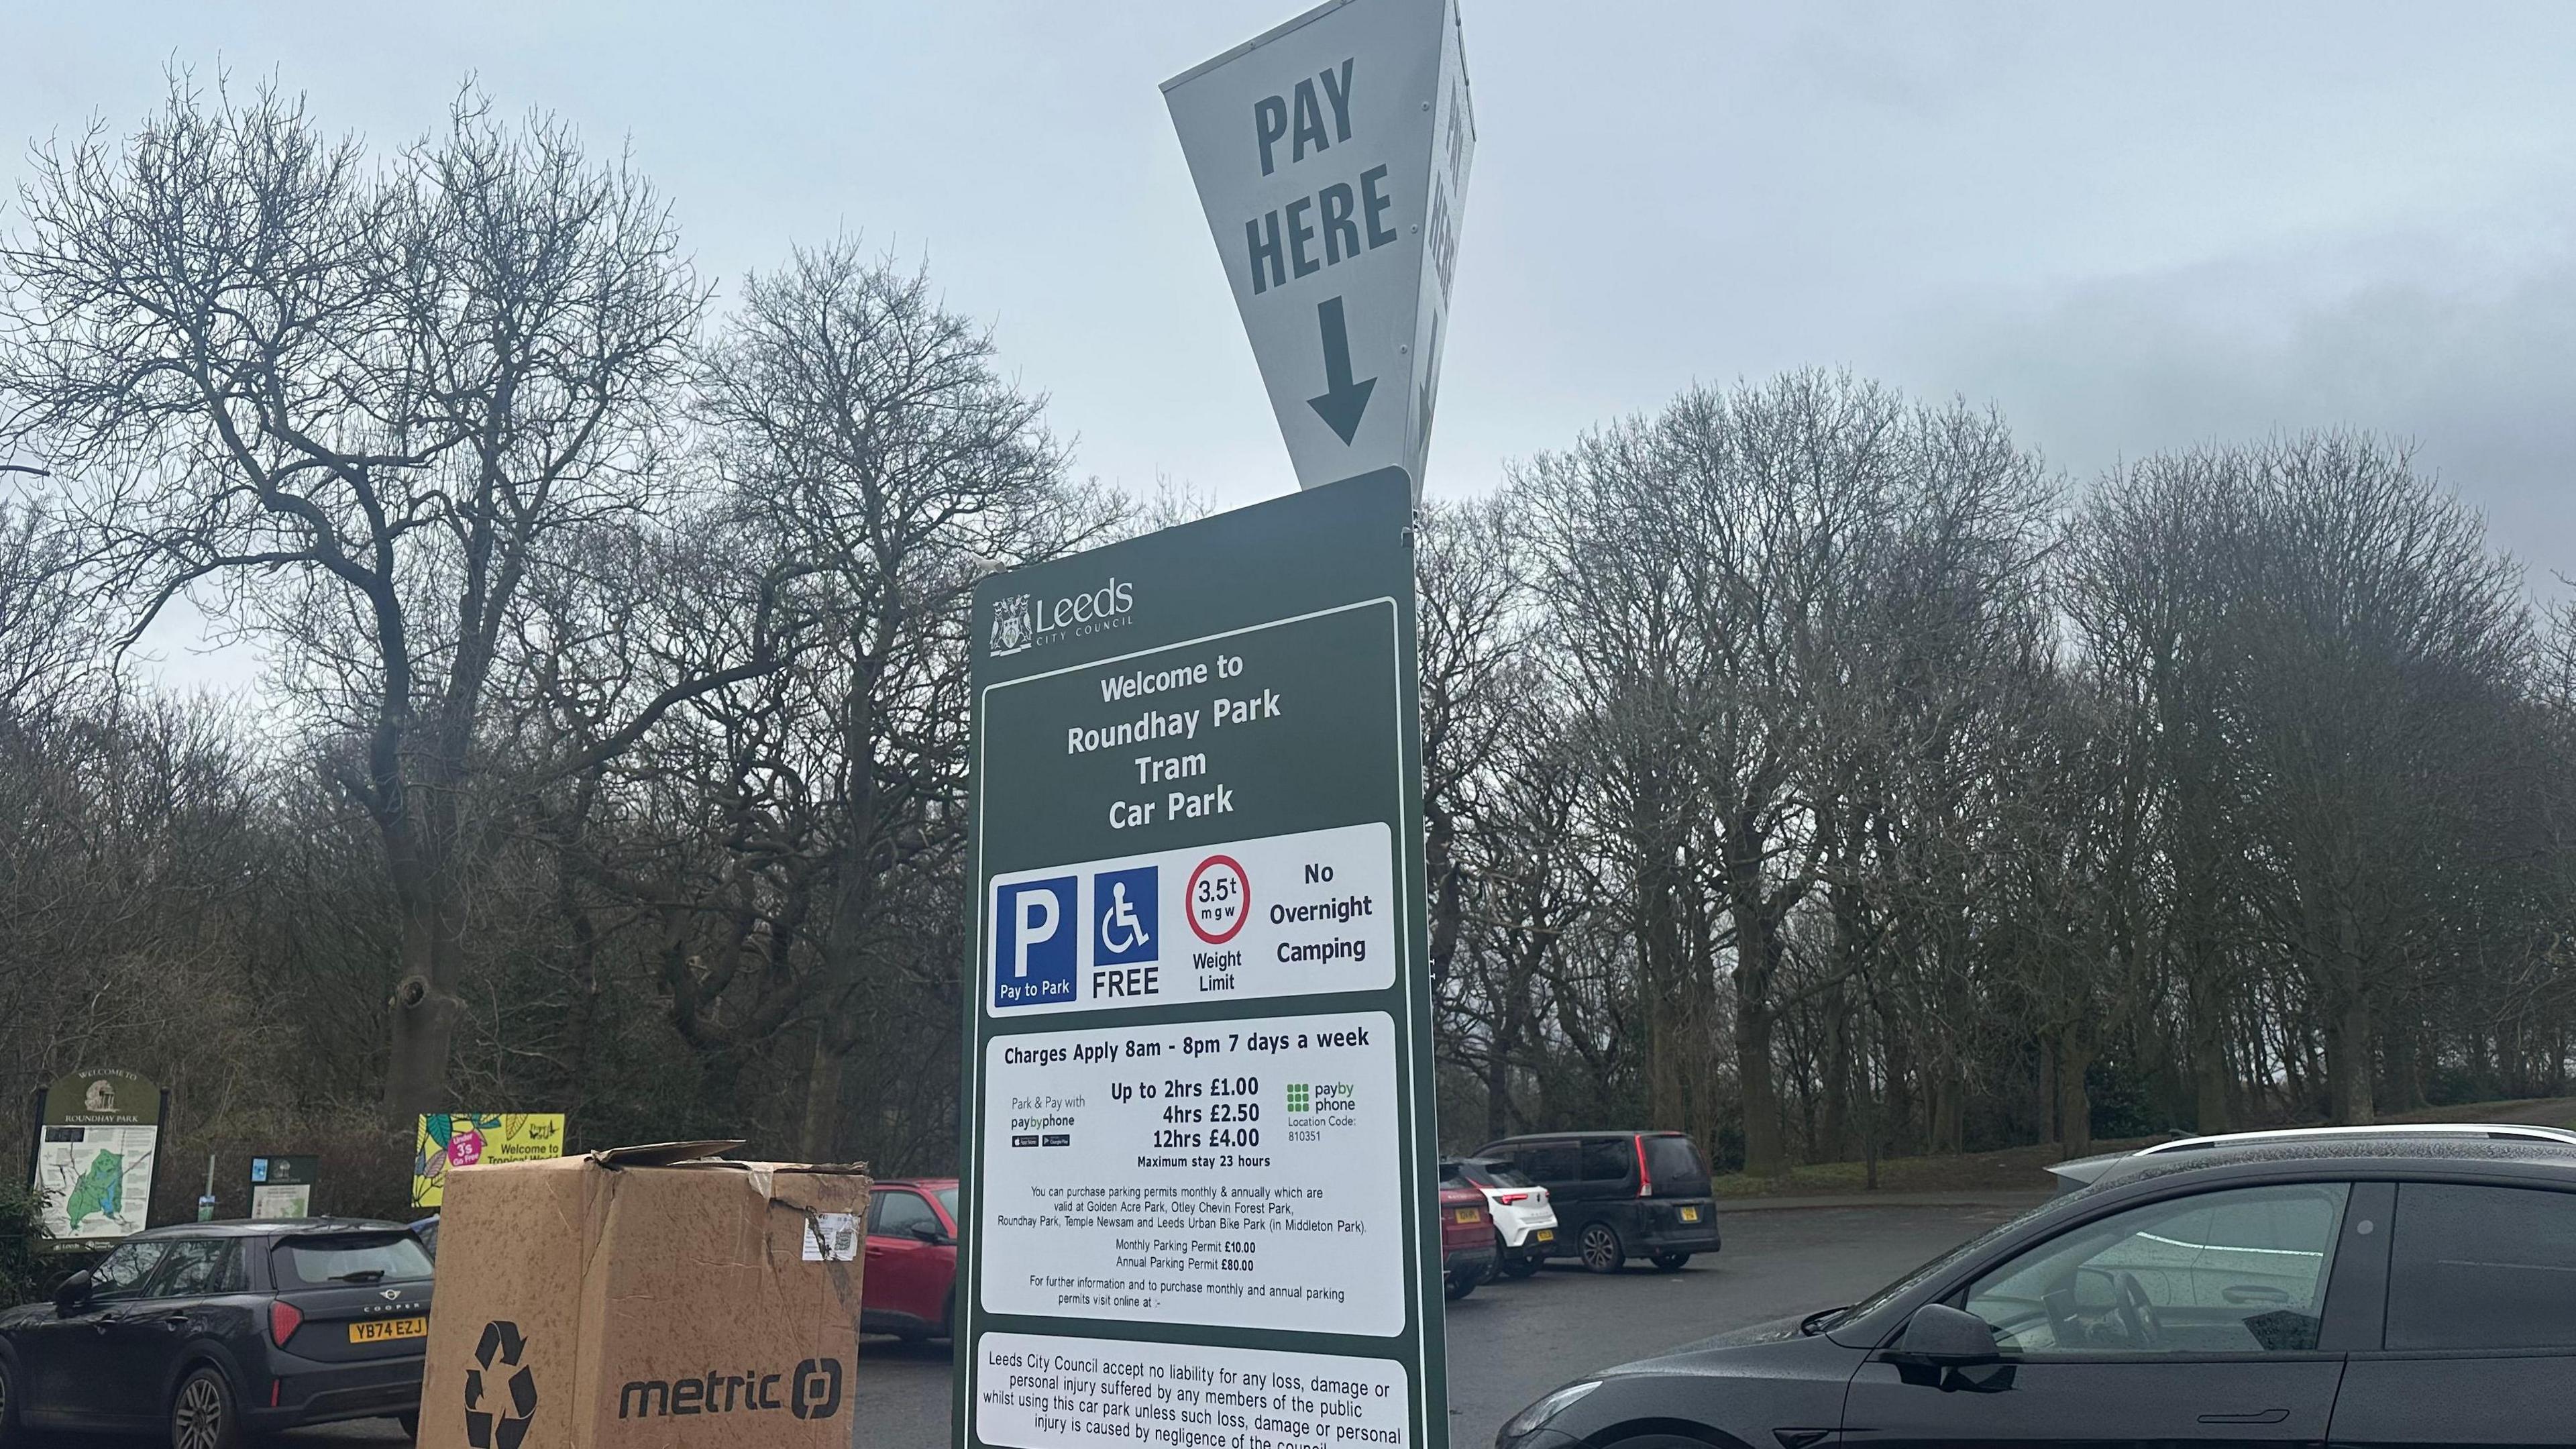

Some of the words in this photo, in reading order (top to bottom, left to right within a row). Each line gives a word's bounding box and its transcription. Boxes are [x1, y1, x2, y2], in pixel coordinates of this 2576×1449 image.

[1254, 57, 1354, 177] PAY
[1245, 163, 1397, 295] HERE
[1037, 578, 1132, 633] Leeds
[1036, 631, 1065, 645] CITY
[1076, 616, 1132, 636] COUNCIL
[1101, 664, 1207, 702] Welcome
[1217, 655, 1242, 678] to
[1069, 710, 1199, 754] Roundhay
[1214, 689, 1280, 727] Park
[1135, 753, 1205, 784] Tram
[1110, 801, 1155, 828] Car
[1169, 784, 1233, 820] Park
[1305, 863, 1333, 883] No
[1202, 910, 1211, 919] m
[1215, 908, 1221, 920] g
[1225, 907, 1234, 916] w
[1271, 896, 1372, 924] Overnight
[1015, 890, 1059, 977] P
[1277, 937, 1365, 964] Camping
[1193, 951, 1241, 971] Weight
[1001, 985, 1020, 1000] Pay
[1025, 983, 1037, 996] to
[1042, 979, 1069, 995] Park
[1093, 967, 1158, 998] FREE
[1200, 973, 1234, 991] Limit
[1005, 1047, 1066, 1066] Charges
[1073, 1041, 1118, 1063] Apply
[1126, 1040, 1160, 1057] 8am
[1183, 1037, 1220, 1057] 8pm
[1229, 1034, 1238, 1051] 7
[1248, 1032, 1289, 1054] days
[1298, 1034, 1307, 1048] a
[1317, 1027, 1368, 1047] week
[79, 1069, 123, 1079] WELCOME
[1112, 1083, 1132, 1104] Up
[1139, 1083, 1156, 1098] to
[1165, 1080, 1201, 1097] 2hrs
[1210, 1077, 1258, 1095] £1.00
[1316, 1082, 1353, 1098] payby
[1012, 1097, 1031, 1109] Park
[1034, 1096, 1042, 1108] &
[1046, 1096, 1062, 1112] Pay
[1065, 1095, 1085, 1108] with
[1316, 1097, 1355, 1114] phone
[1012, 1114, 1074, 1130] paybyphone
[1163, 1106, 1201, 1123] 4hrs
[1210, 1104, 1258, 1122] £2.50
[1289, 1117, 1326, 1126] Location
[1328, 1115, 1355, 1126] Code:
[453, 1133, 472, 1144] Under
[1155, 1130, 1200, 1147] 12hrs
[1210, 1128, 1258, 1146] £4.00
[1289, 1131, 1320, 1141] 810351
[457, 1142, 472, 1157] 3's
[464, 1153, 478, 1163] Free
[501, 1144, 546, 1154] Welcome
[549, 1144, 559, 1153] to
[1138, 1156, 1187, 1167] Maximum
[1192, 1157, 1215, 1169] stay
[1220, 1155, 1232, 1166] 23
[1238, 1155, 1270, 1166] hours
[1031, 1187, 1045, 1196] You
[1067, 1186, 1105, 1199] purchase
[1109, 1186, 1140, 1199] parking
[1144, 1187, 1177, 1199] permits
[1181, 1187, 1216, 1199] monthly
[1221, 1186, 1227, 1197] &
[1232, 1187, 1270, 1200] annually
[1275, 1187, 1302, 1197] which
[1307, 1189, 1322, 1198] are
[1055, 1201, 1072, 1211] valid
[1076, 1202, 1083, 1211] at
[1087, 1201, 1116, 1212] Golden
[1120, 1201, 1140, 1212] Acre
[1145, 1201, 1167, 1213] Park,
[1171, 1201, 1195, 1215] Otley
[1199, 1202, 1230, 1213] Chevin
[1235, 1202, 1264, 1214] Forest
[1269, 1203, 1293, 1216] Park,
[998, 1216, 1036, 1228] Roundhay
[1040, 1216, 1060, 1226] Park,
[1065, 1216, 1093, 1228] Temple
[1097, 1216, 1133, 1227] Newsam
[1137, 1217, 1153, 1228] and
[1158, 1217, 1184, 1228] Leeds
[1189, 1217, 1216, 1228] Urban
[1220, 1218, 1239, 1229] Bike
[1244, 1218, 1265, 1229] Park
[1269, 1219, 1281, 1232] (in
[1286, 1219, 1332, 1231] Middleton
[1338, 1220, 1366, 1234] Park).
[1116, 1239, 1150, 1252] Monthly
[1154, 1240, 1187, 1254] Parking
[1191, 1240, 1222, 1252] Permit
[1225, 1241, 1255, 1252] £10.00
[1116, 1256, 1146, 1267] Annual
[1150, 1256, 1183, 1271] Parking
[1189, 1258, 1218, 1269] Permit
[1222, 1259, 1253, 1271] £80.00
[1030, 1275, 1043, 1286] For
[1046, 1276, 1074, 1287] further
[1077, 1277, 1124, 1289] information
[1128, 1279, 1144, 1290] and
[1148, 1280, 1157, 1291] to
[1161, 1281, 1202, 1293] purchase
[1207, 1283, 1243, 1297] monthly
[1248, 1285, 1265, 1295] and
[1269, 1287, 1301, 1297] annual
[1307, 1288, 1344, 1303] parking
[364, 1303, 419, 1312] COOPER
[1059, 1293, 1089, 1305] permits
[1093, 1295, 1110, 1305] visit
[1114, 1295, 1139, 1306] online
[1143, 1297, 1151, 1307] at
[356, 1323, 392, 1339] YB74
[396, 1320, 421, 1335] EZJ
[989, 1351, 1022, 1366] Leeds
[1028, 1354, 1049, 1373] City
[1055, 1356, 1097, 1373] Council
[1103, 1363, 1143, 1379] accept
[1150, 1366, 1164, 1378] no
[1170, 1364, 1214, 1385] liability
[1220, 1368, 1237, 1383] for
[1243, 1374, 1266, 1391] any
[1273, 1373, 1303, 1392] loss,
[1311, 1376, 1368, 1399] damage
[1375, 1385, 1389, 1397] or
[619, 1370, 781, 1419] metric
[1010, 1375, 1058, 1395] personal
[1064, 1380, 1095, 1396] injury
[1102, 1381, 1151, 1397] suffered
[1158, 1384, 1171, 1403] by
[1177, 1389, 1199, 1405] any
[1205, 1391, 1267, 1408] members
[1273, 1395, 1286, 1409] of
[1292, 1396, 1313, 1412] the
[1321, 1399, 1362, 1417] public
